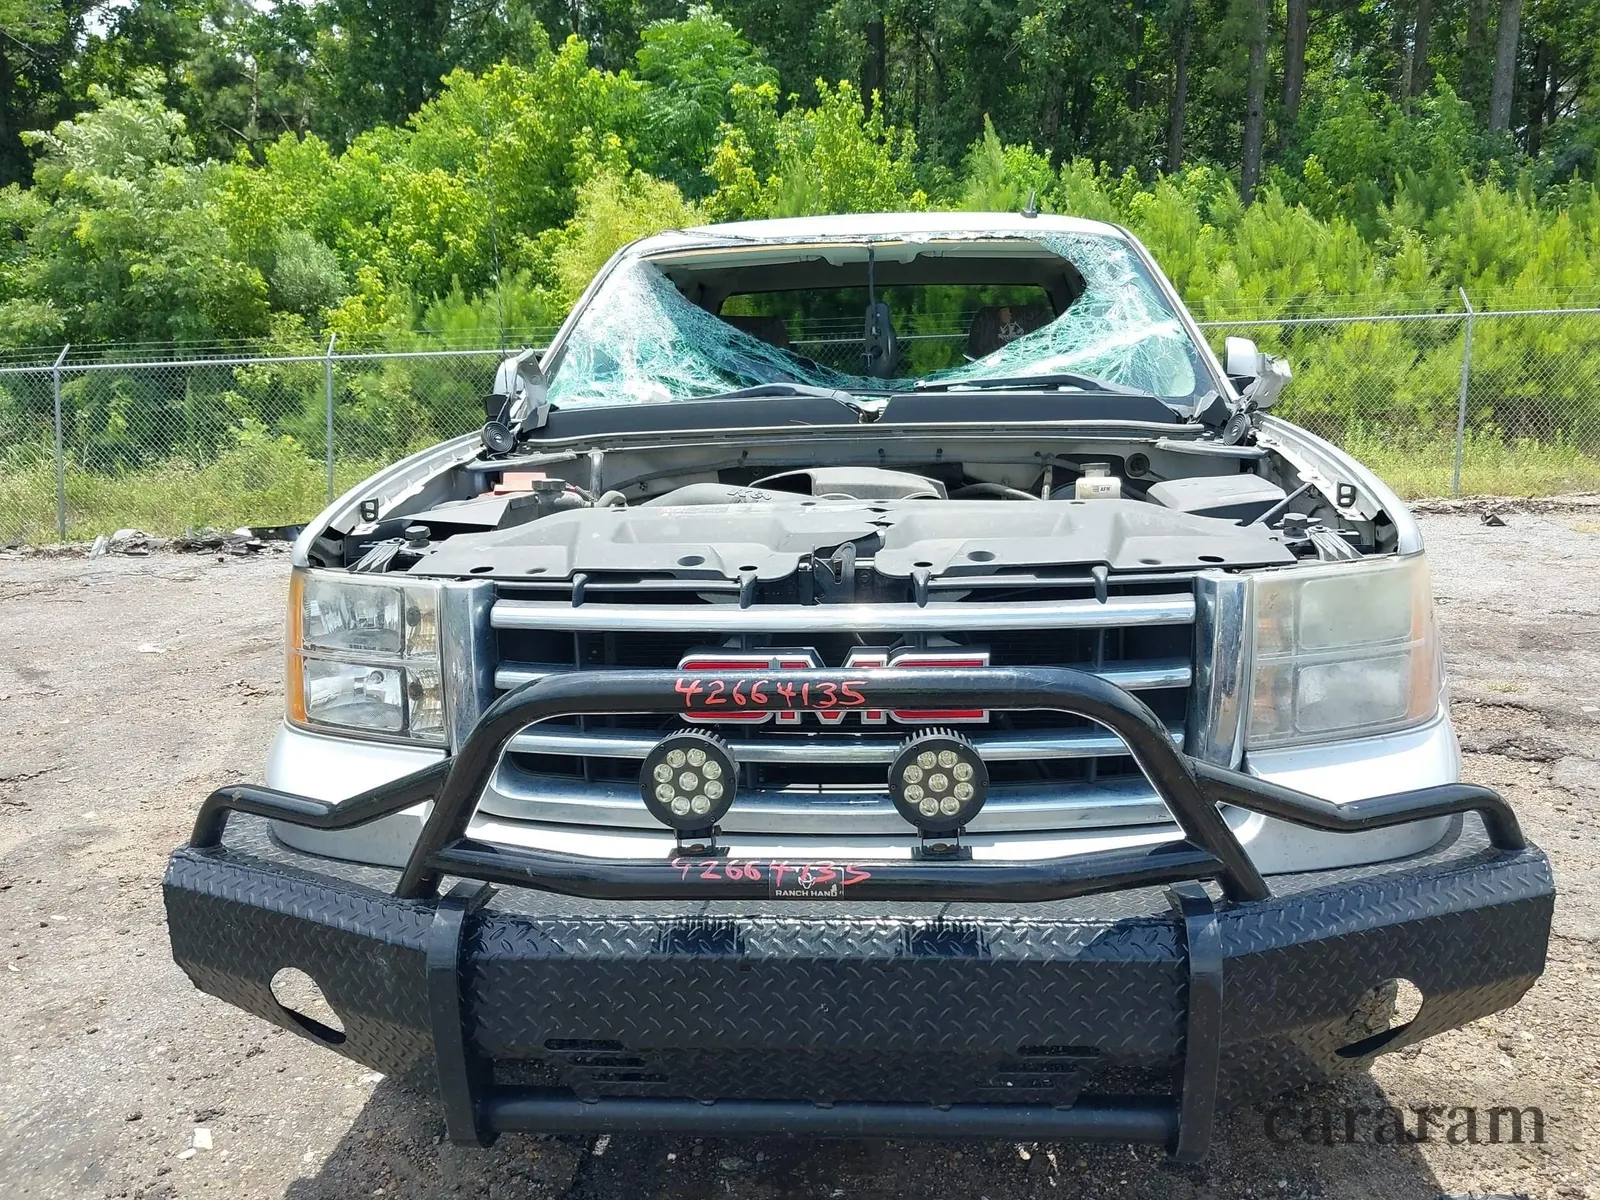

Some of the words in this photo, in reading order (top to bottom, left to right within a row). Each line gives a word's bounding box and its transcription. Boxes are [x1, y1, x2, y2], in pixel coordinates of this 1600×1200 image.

[674, 677, 869, 708] 42664135
[775, 889, 809, 897] RANCH
[810, 889, 838, 897] HAND
